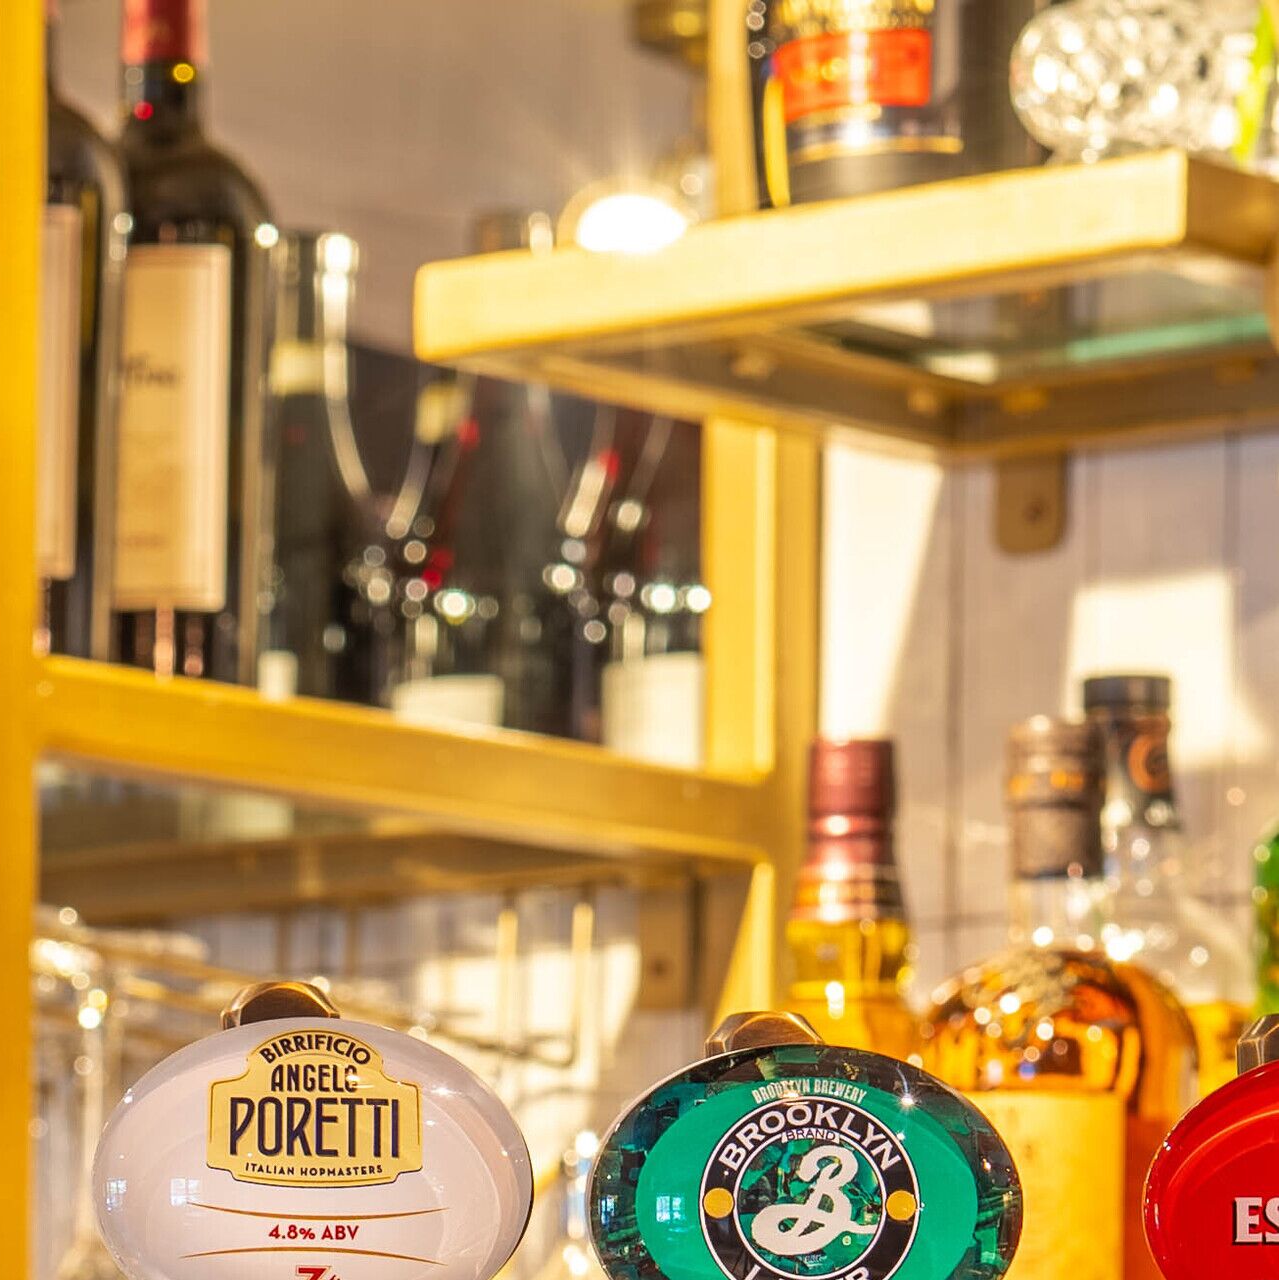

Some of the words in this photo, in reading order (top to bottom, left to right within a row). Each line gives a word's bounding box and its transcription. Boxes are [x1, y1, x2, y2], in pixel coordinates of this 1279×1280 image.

[261, 1035, 371, 1064] BIRRIFICIO
[270, 1065, 358, 1093] ANGELO
[814, 1079, 867, 1104] BREWERY
[229, 1097, 400, 1158] PORETTI
[718, 1104, 901, 1172] BROOKLYN
[786, 1128, 836, 1142] BRAND
[245, 1162, 295, 1175] ITALIAN
[300, 1164, 383, 1177] HOPMASTERS
[268, 1224, 315, 1240] 4.8%
[321, 1225, 359, 1240] ABV
